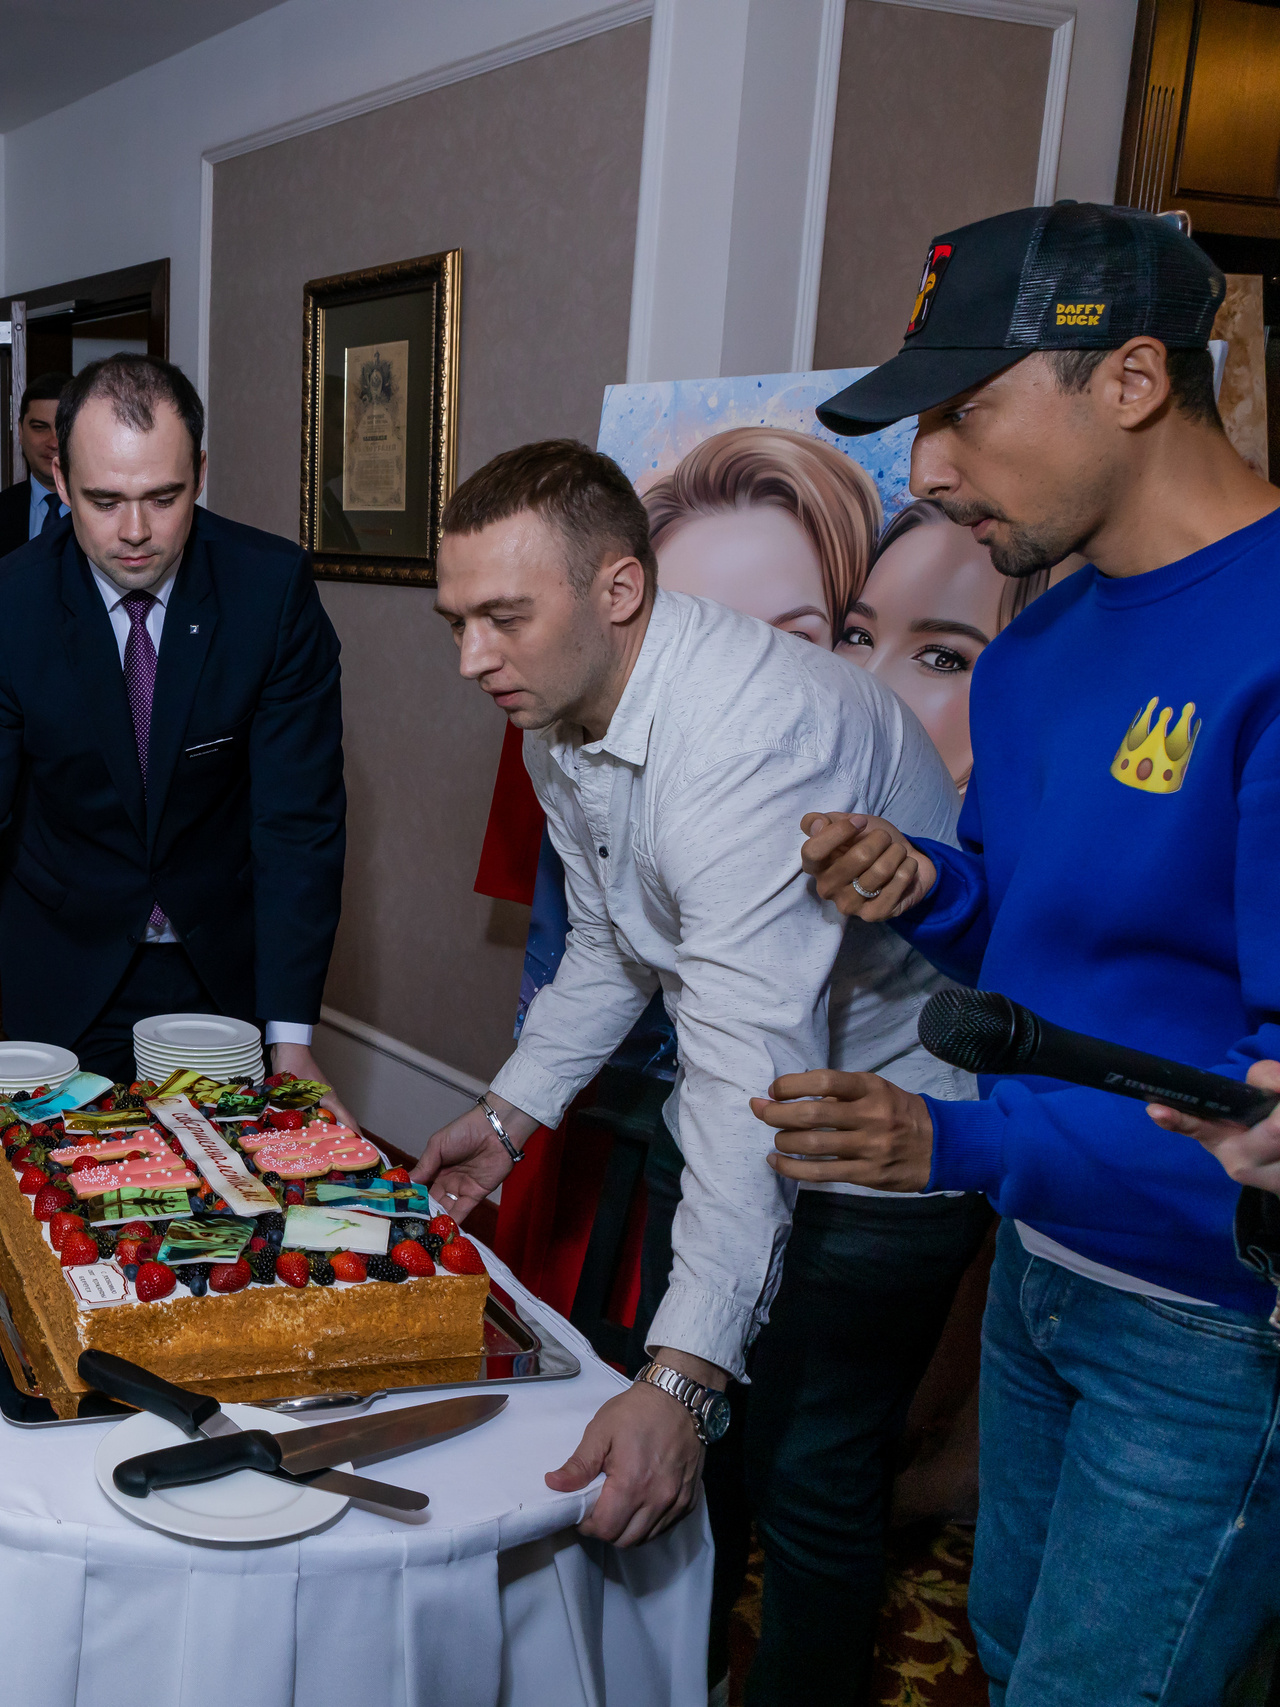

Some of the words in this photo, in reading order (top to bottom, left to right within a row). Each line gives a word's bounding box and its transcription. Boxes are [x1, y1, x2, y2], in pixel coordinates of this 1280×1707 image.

[1056, 303, 1106, 315] DAFFY
[1056, 314, 1100, 326] DUCK
[237, 1118, 381, 1180] 18
